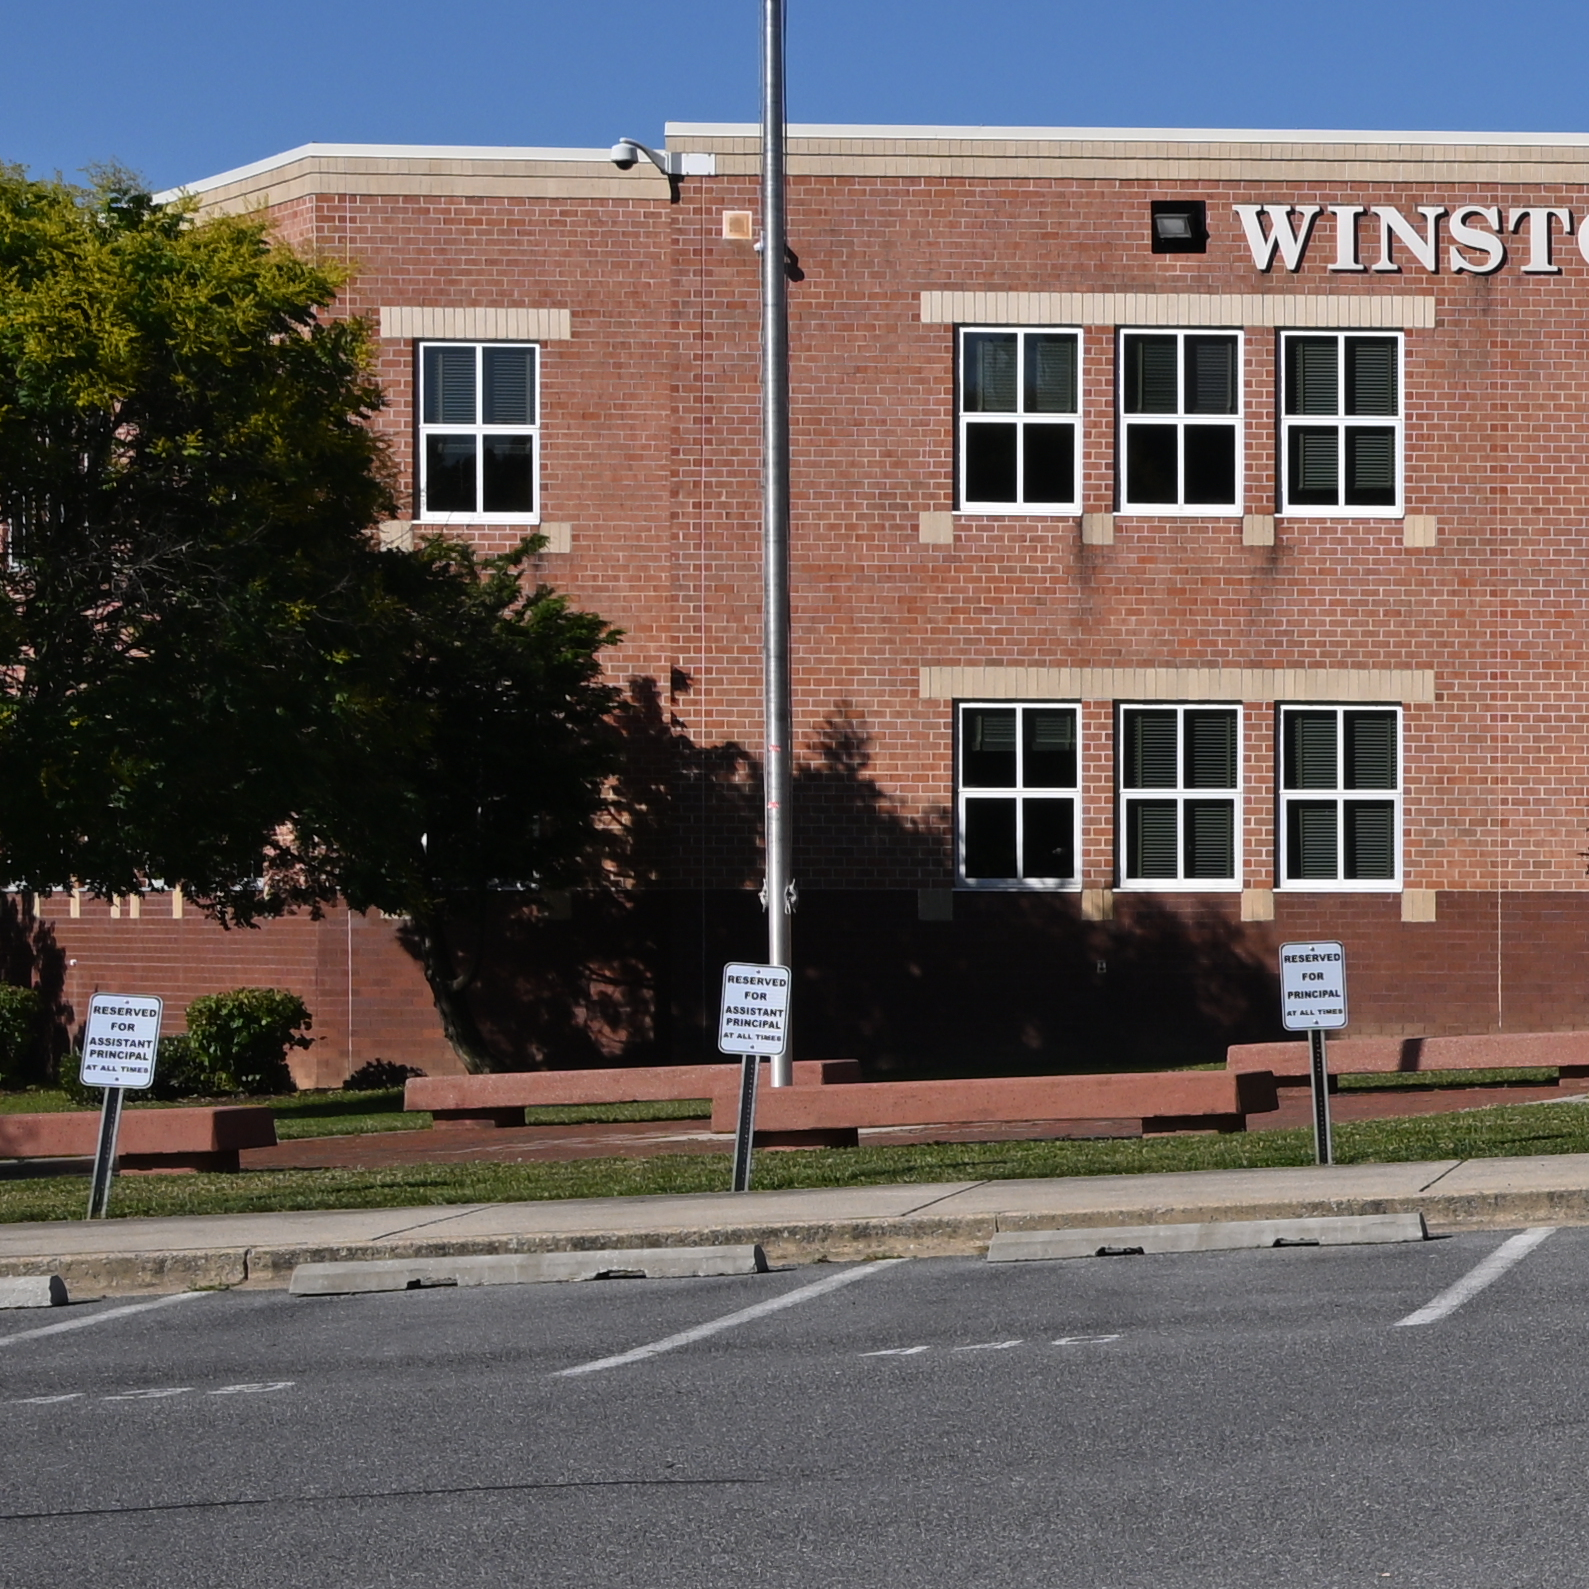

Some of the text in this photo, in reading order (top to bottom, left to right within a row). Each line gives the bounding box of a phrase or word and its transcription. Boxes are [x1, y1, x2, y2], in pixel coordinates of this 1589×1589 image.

[1283, 953, 1341, 963] RESERVED
[728, 975, 787, 987] RESERVED
[1301, 972, 1324, 981] FOR
[744, 991, 768, 1001] FOR
[1287, 989, 1341, 1000] PRINCIPAL
[93, 1005, 157, 1018] RESERVED
[725, 1005, 784, 1018] ASSISTANT
[110, 1022, 136, 1032] FOR
[726, 1017, 782, 1030] PRINCIPAL
[89, 1036, 153, 1049] ASSISTANT
[736, 1032, 753, 1040] ALL
[755, 1033, 782, 1042] TIMES
[89, 1049, 149, 1061] PRINCIPAL
[100, 1064, 118, 1072] ALL
